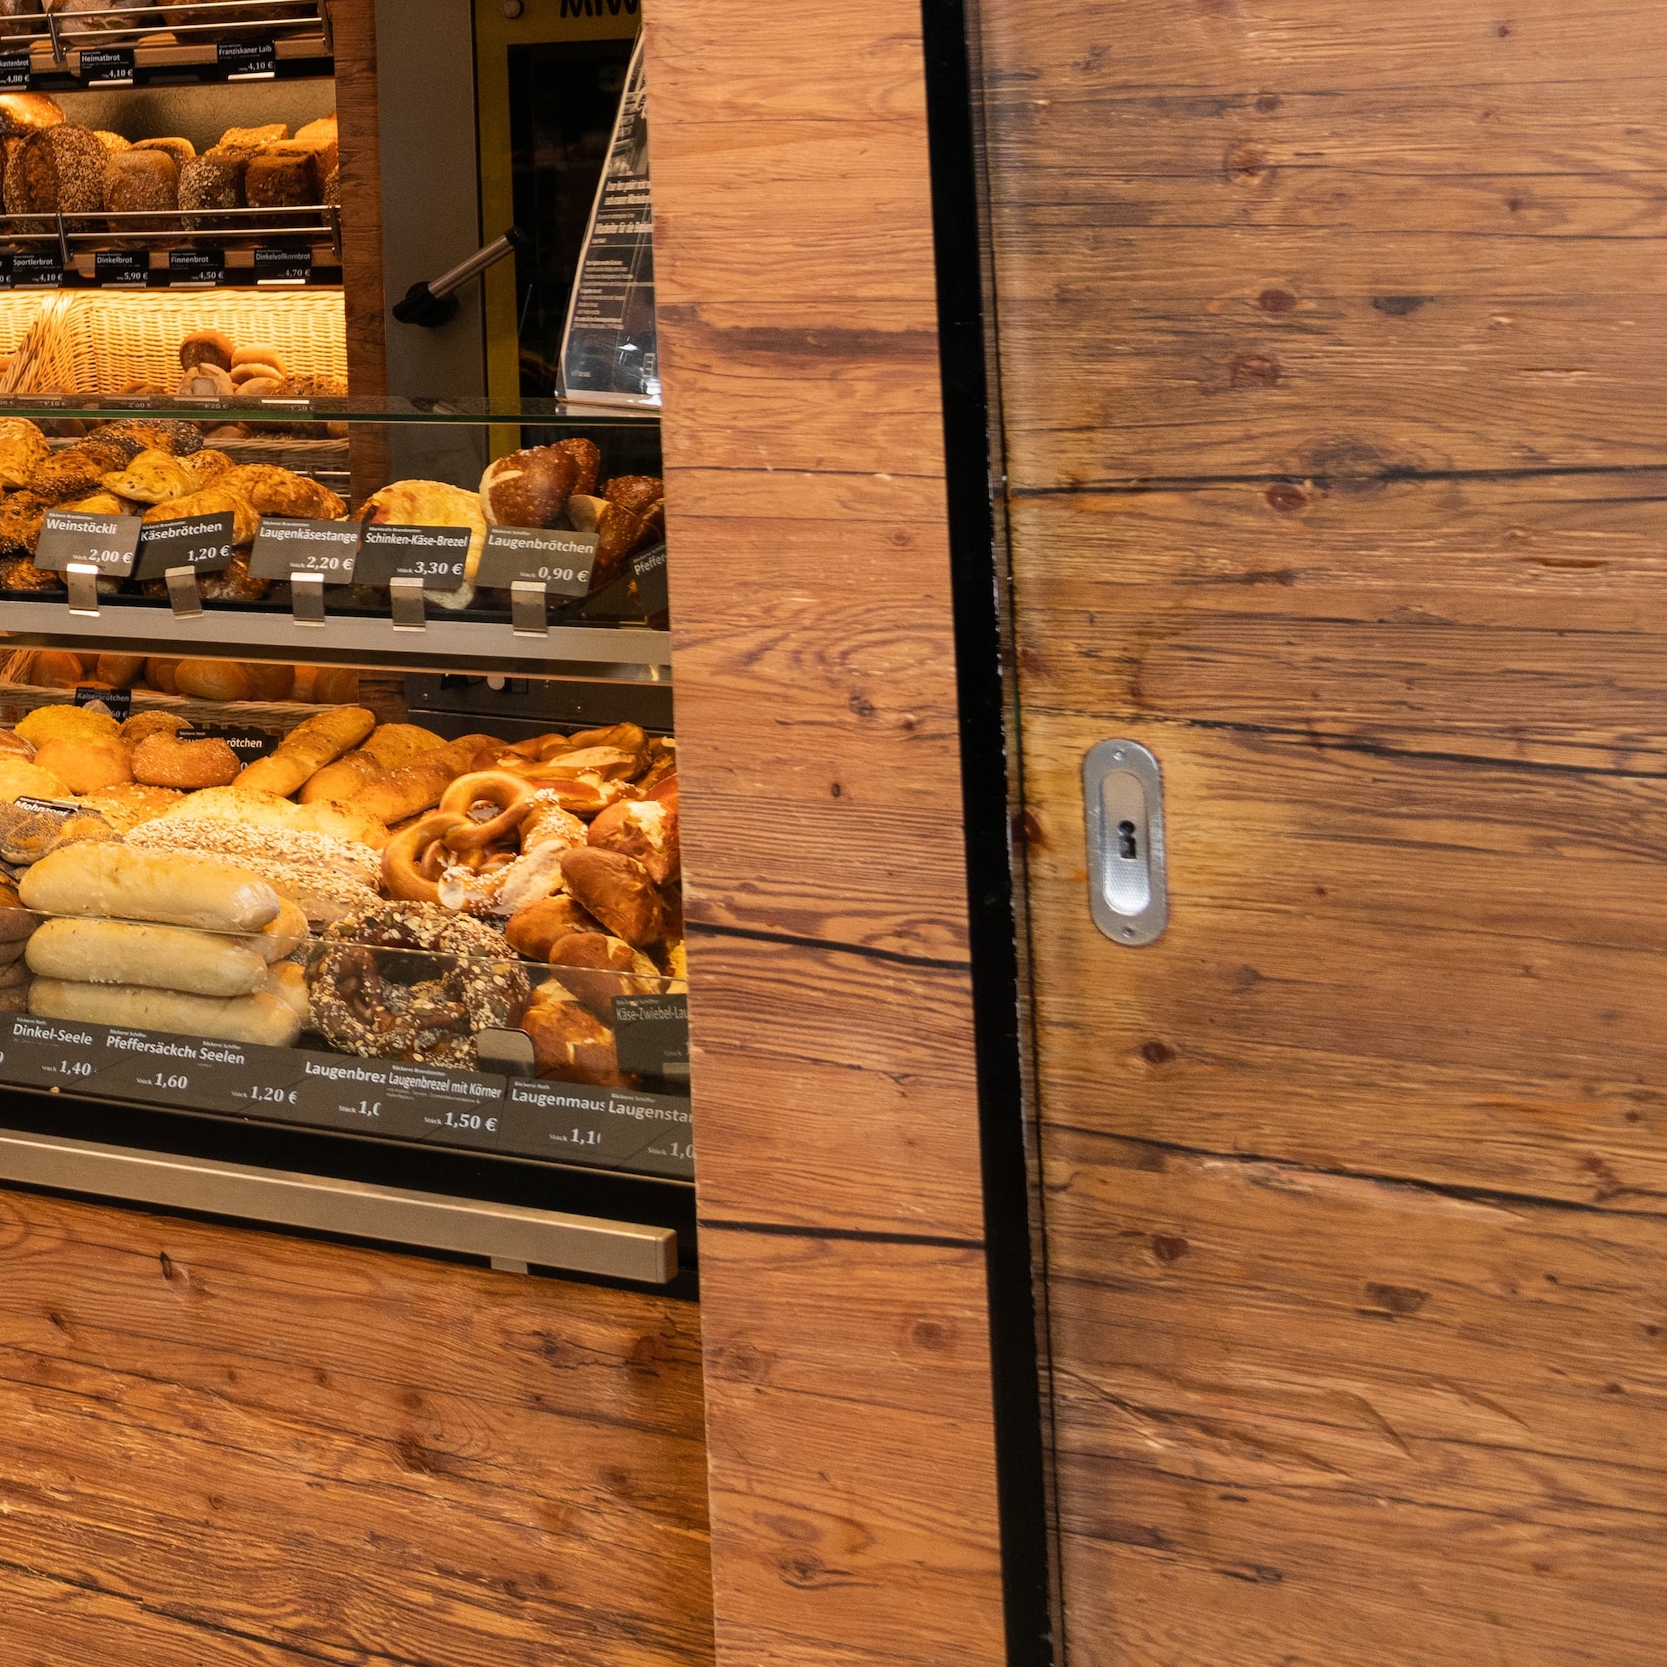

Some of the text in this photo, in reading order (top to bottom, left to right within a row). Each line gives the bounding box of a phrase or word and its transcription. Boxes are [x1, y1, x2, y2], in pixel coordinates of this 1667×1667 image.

[81, 53, 121, 63] Heimatbrot
[13, 257, 54, 266] Sportlerbrot
[96, 256, 133, 264] Dinkelbrot
[171, 255, 209, 264] Finnenbrot
[255, 252, 311, 261] Dinkelvollkornbrot
[45, 518, 117, 535] Weinstöckli
[140, 521, 223, 542] Käsebrötchen
[259, 526, 358, 544] Laugenkäsestange
[365, 532, 468, 547] Schinken-Käse-Brezel
[487, 534, 595, 555] Laugenbrötchen
[88, 548, 119, 564] 2,00
[187, 547, 217, 562] 1,20
[306, 555, 339, 571] 2,20
[413, 560, 449, 575] 3,30
[537, 566, 573, 582] 0,90
[13, 1022, 93, 1046] Dinkel-Seele
[199, 1047, 245, 1066] Seelen
[59, 1060, 92, 1077] 1,40
[154, 1072, 188, 1090] 1,60
[388, 1071, 502, 1099] Laugenbrezel mit Körner
[250, 1085, 285, 1103] 1,20
[443, 1111, 481, 1130] 1,50
